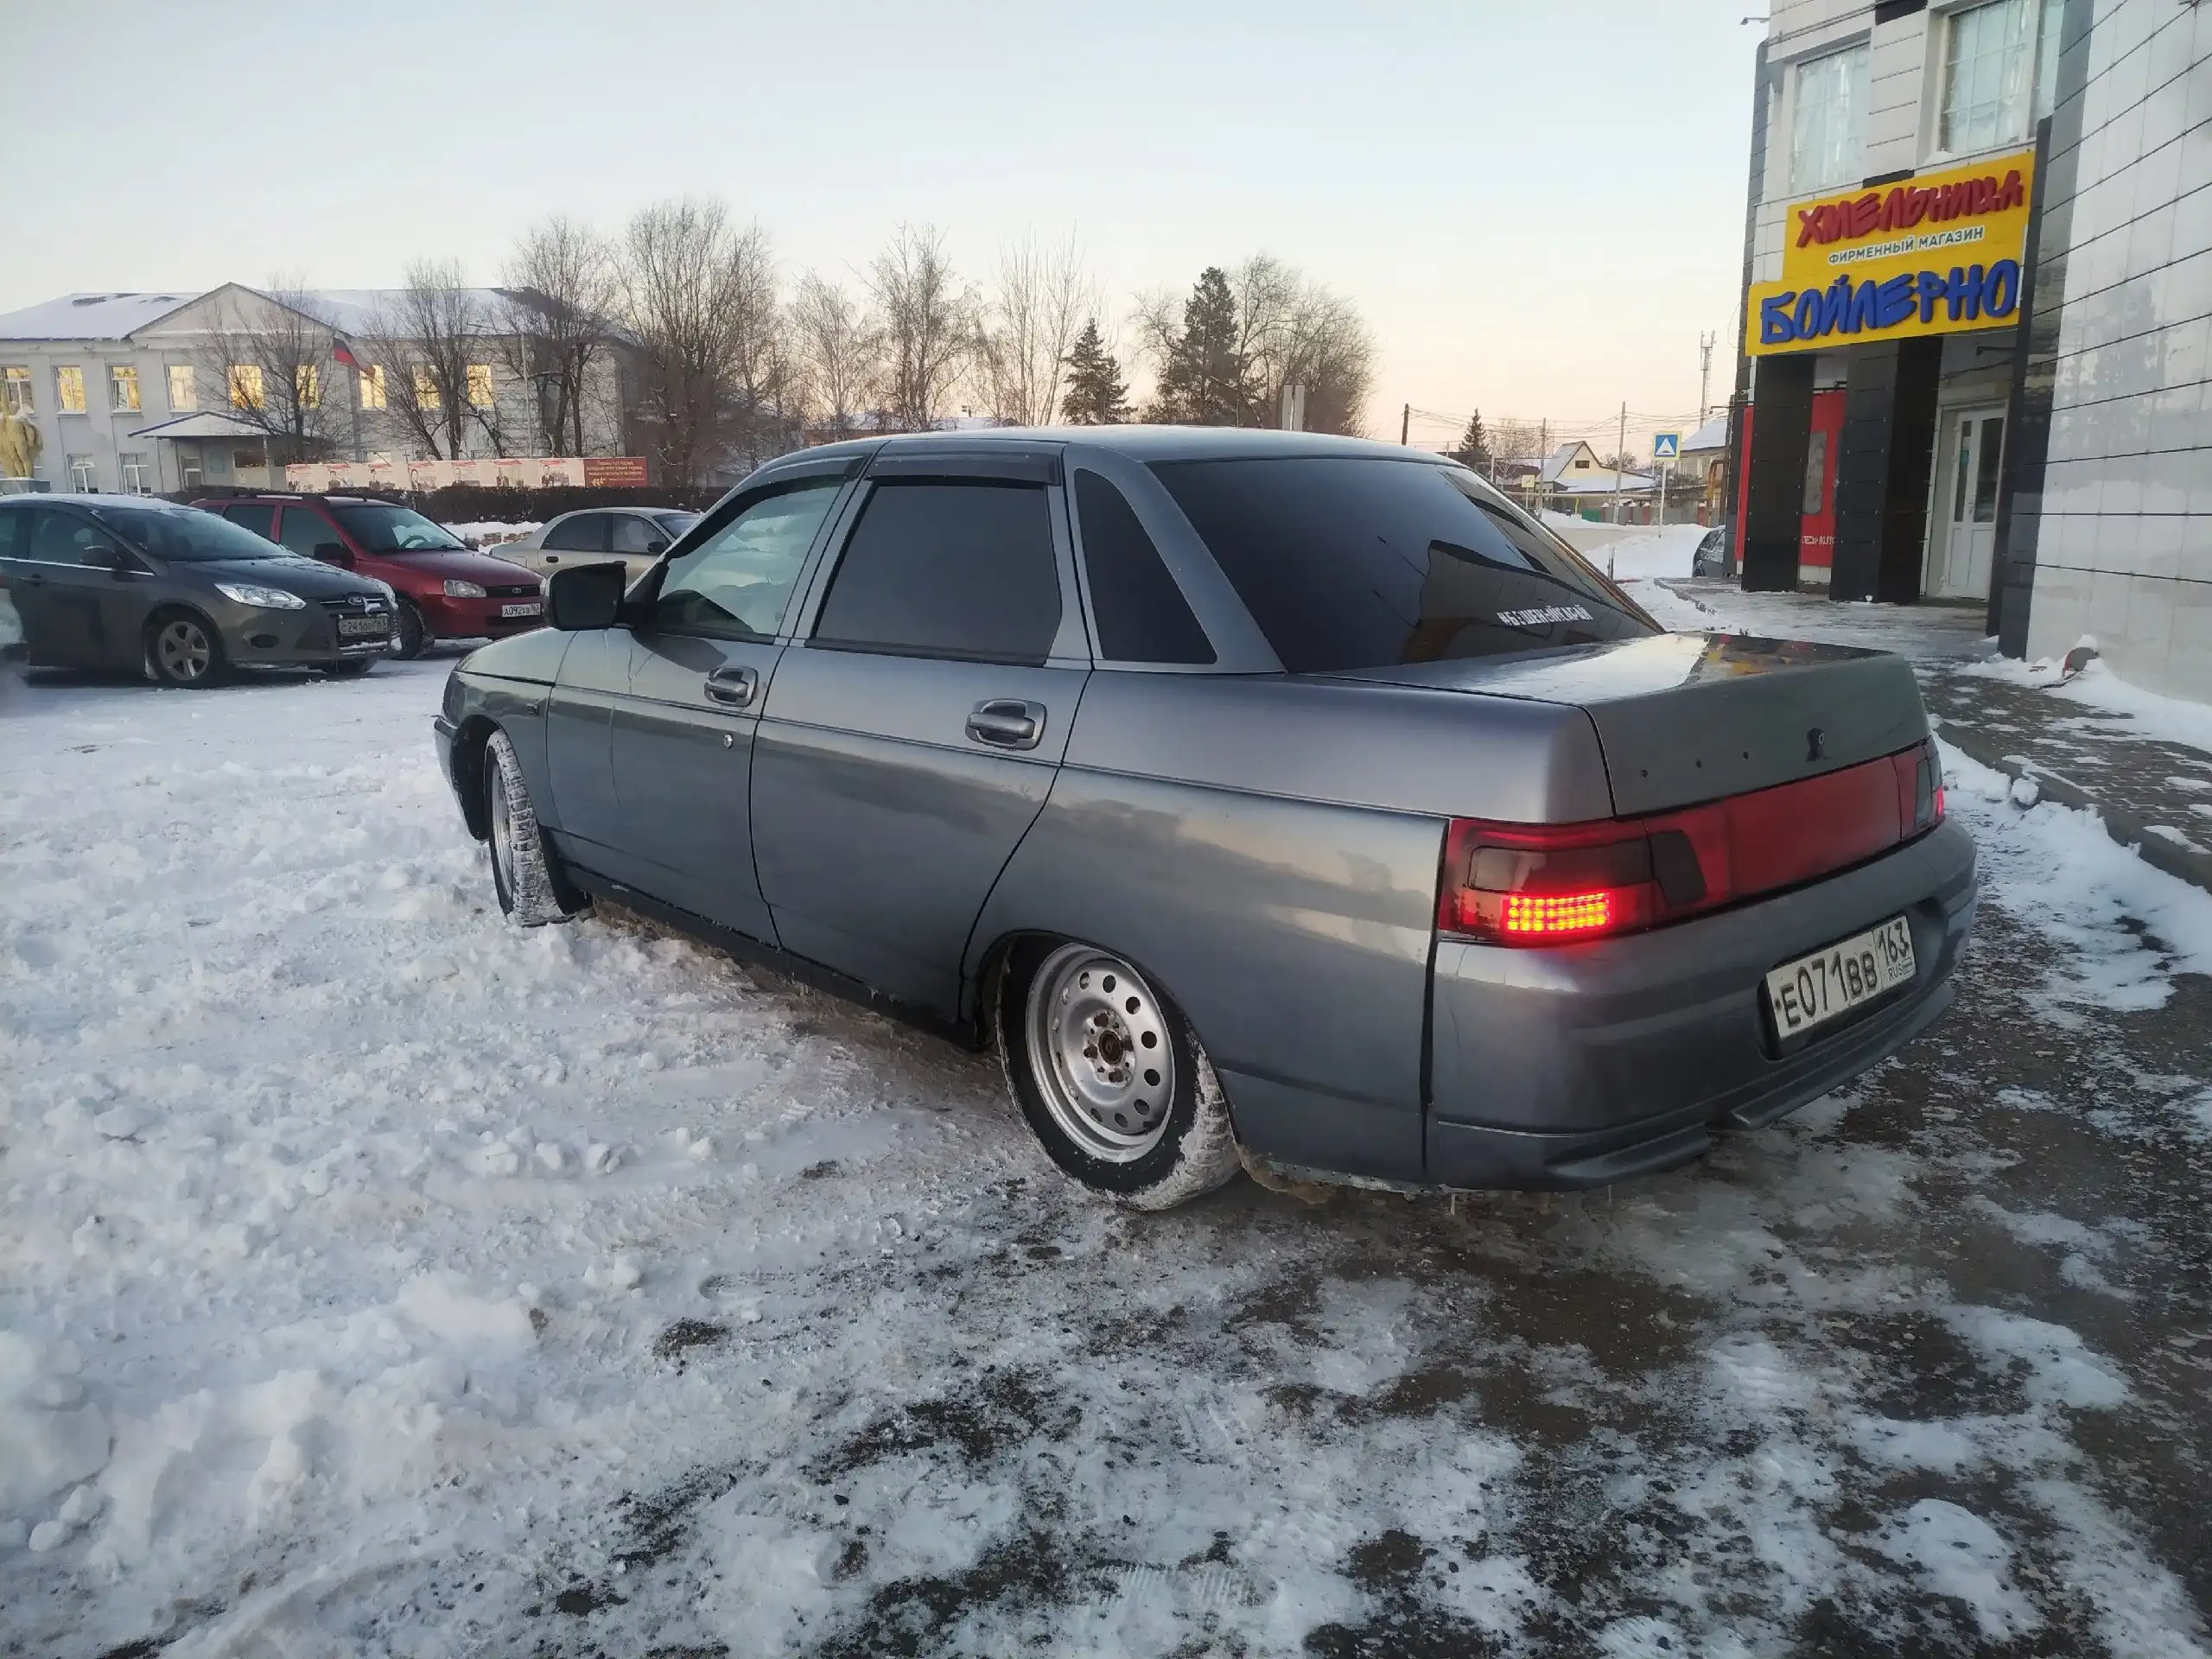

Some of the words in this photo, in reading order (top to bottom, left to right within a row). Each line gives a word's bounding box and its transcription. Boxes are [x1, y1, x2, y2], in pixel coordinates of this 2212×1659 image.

[1796, 169, 2024, 248] ХМЕЛЬНИЦА
[1828, 236, 1914, 264] ФИРМЕННЫЙ
[1918, 226, 1985, 250] МАГАЗИН
[1760, 259, 2020, 345] БОЙЛЕРНО
[1780, 950, 1878, 1028] Е071ВВ
[1877, 921, 1910, 968] 163
[1887, 963, 1904, 982] RUS
